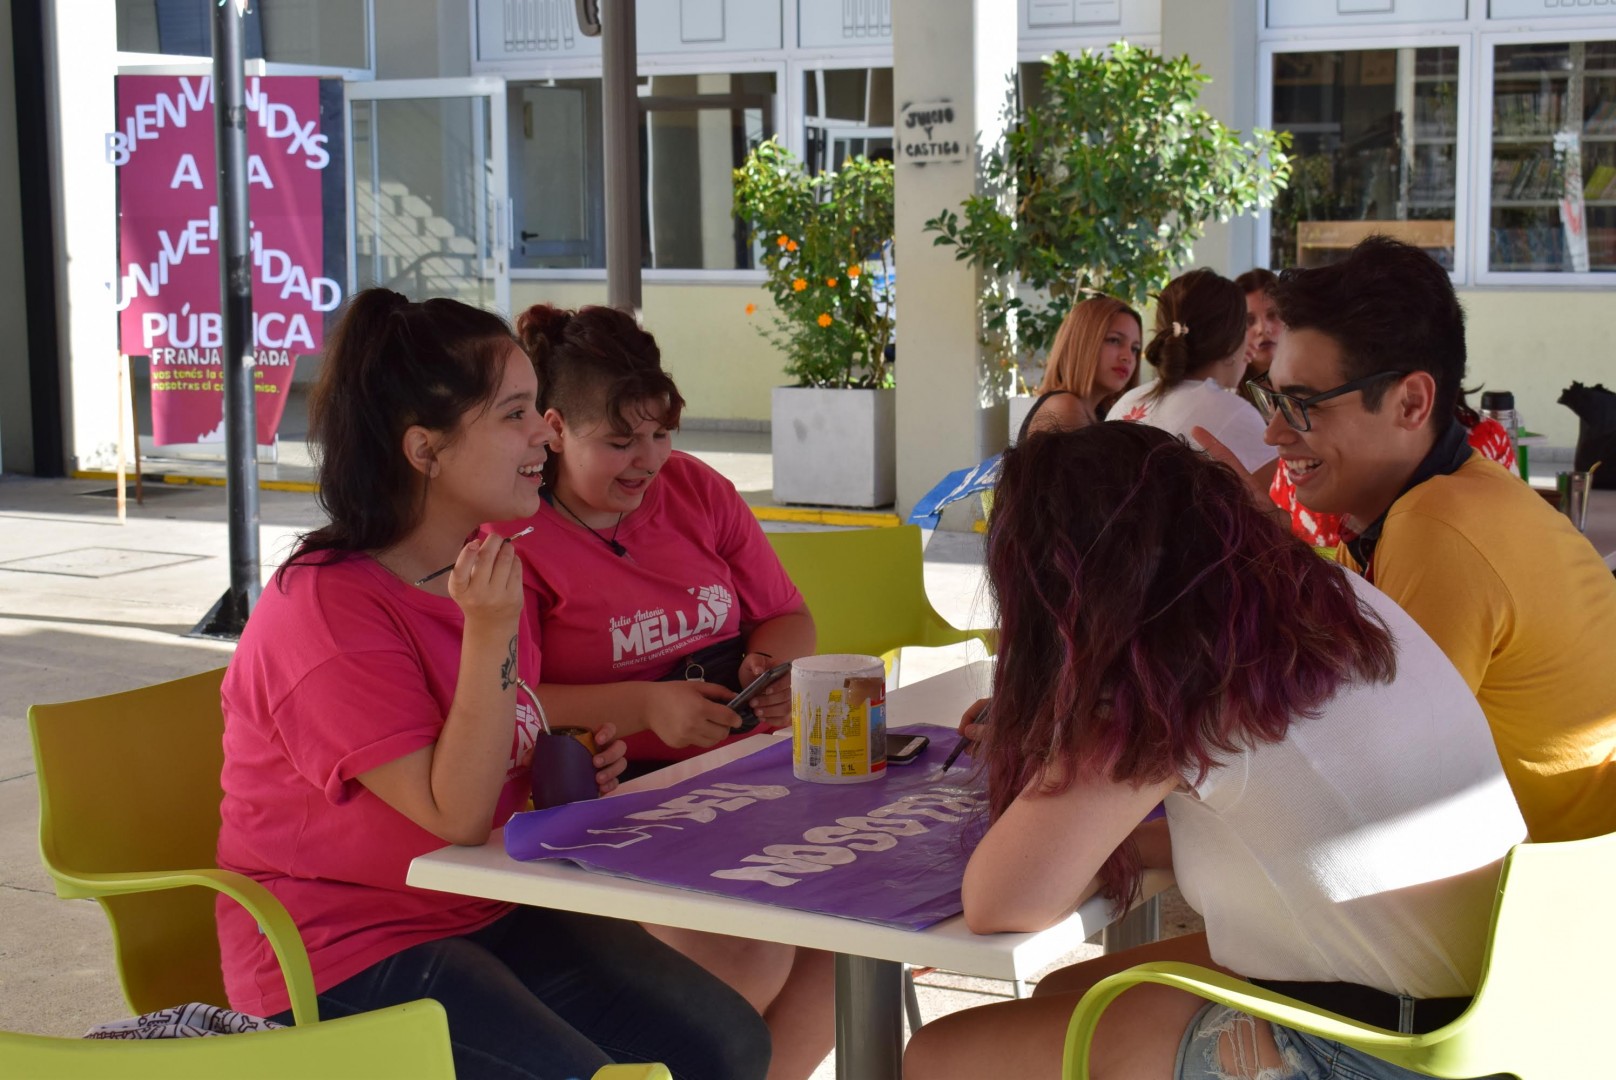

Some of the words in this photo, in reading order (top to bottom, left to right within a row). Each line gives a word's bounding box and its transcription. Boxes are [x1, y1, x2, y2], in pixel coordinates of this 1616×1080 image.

[105, 77, 330, 169] BIENVNIDXS
[924, 126, 933, 140] Y
[905, 141, 959, 157] CASTIGO
[170, 154, 203, 189] A
[248, 155, 273, 189] A
[105, 206, 341, 311] UNIVEIDAD
[142, 302, 314, 349] PÚBICA
[152, 348, 221, 366] FRANJA
[609, 617, 631, 632] Julio
[634, 608, 665, 623] Antonio
[612, 603, 715, 662] MELLA
[613, 656, 648, 669] CORRIENTE
[710, 786, 986, 887] NOSOTR
